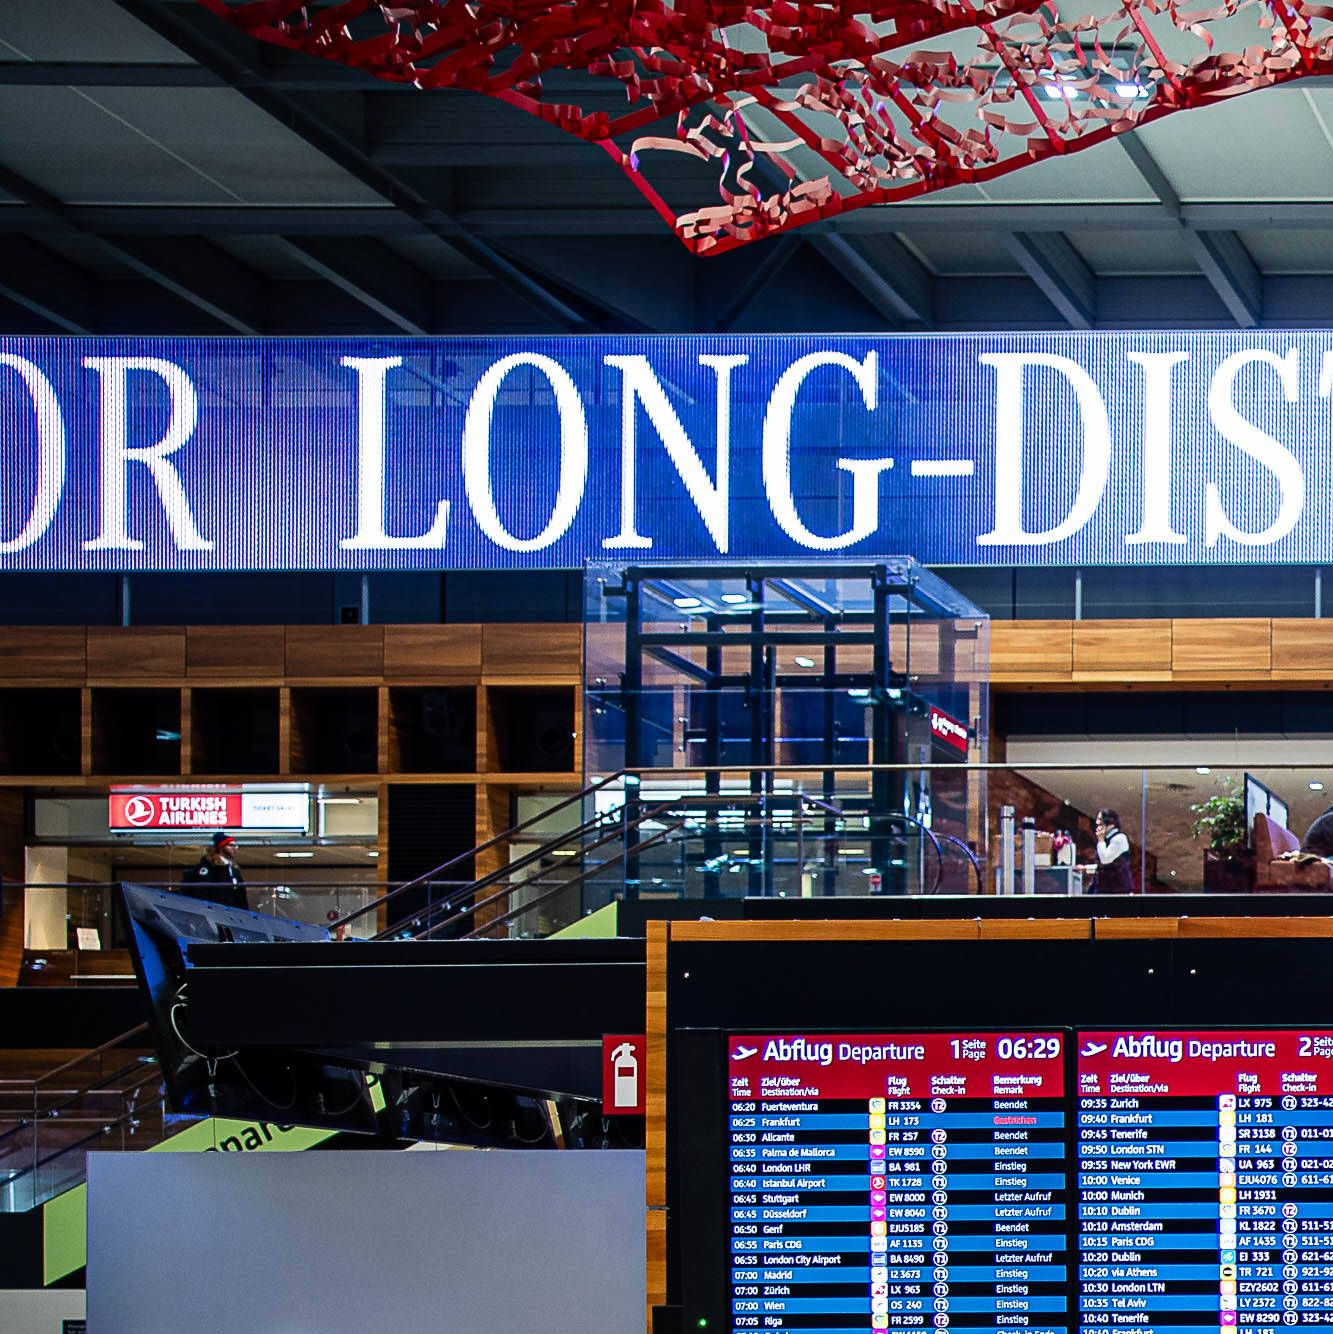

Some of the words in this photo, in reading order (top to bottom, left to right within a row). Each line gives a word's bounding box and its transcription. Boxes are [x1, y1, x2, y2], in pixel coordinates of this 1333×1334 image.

[159, 797, 226, 811] TURKISH
[159, 811, 227, 825] AIRLINES
[951, 1040, 959, 1058] 1
[963, 1040, 986, 1049] Seite
[998, 1039, 1060, 1058] 06:29
[1113, 1036, 1182, 1062] Abflug
[1190, 1041, 1275, 1061] Departure
[1299, 1037, 1311, 1056] 2
[764, 1039, 832, 1065] Abflug
[840, 1044, 924, 1064] Departure
[963, 1048, 985, 1061] Page
[732, 1103, 755, 1111] 06:20
[762, 1103, 818, 1111] Fuerteventura
[889, 1102, 898, 1110] FR
[900, 1102, 921, 1110] 3354
[995, 1100, 1027, 1108] Beendet
[763, 1164, 792, 1172] London
[795, 1164, 810, 1172] LHR
[889, 1163, 901, 1171] BA
[904, 1163, 920, 1171] 981
[995, 1162, 1026, 1172] Einstieg
[1082, 1191, 1107, 1200] 10:00
[1112, 1191, 1144, 1200] Munich
[1239, 1191, 1251, 1199] LH
[1254, 1191, 1276, 1199] 1931
